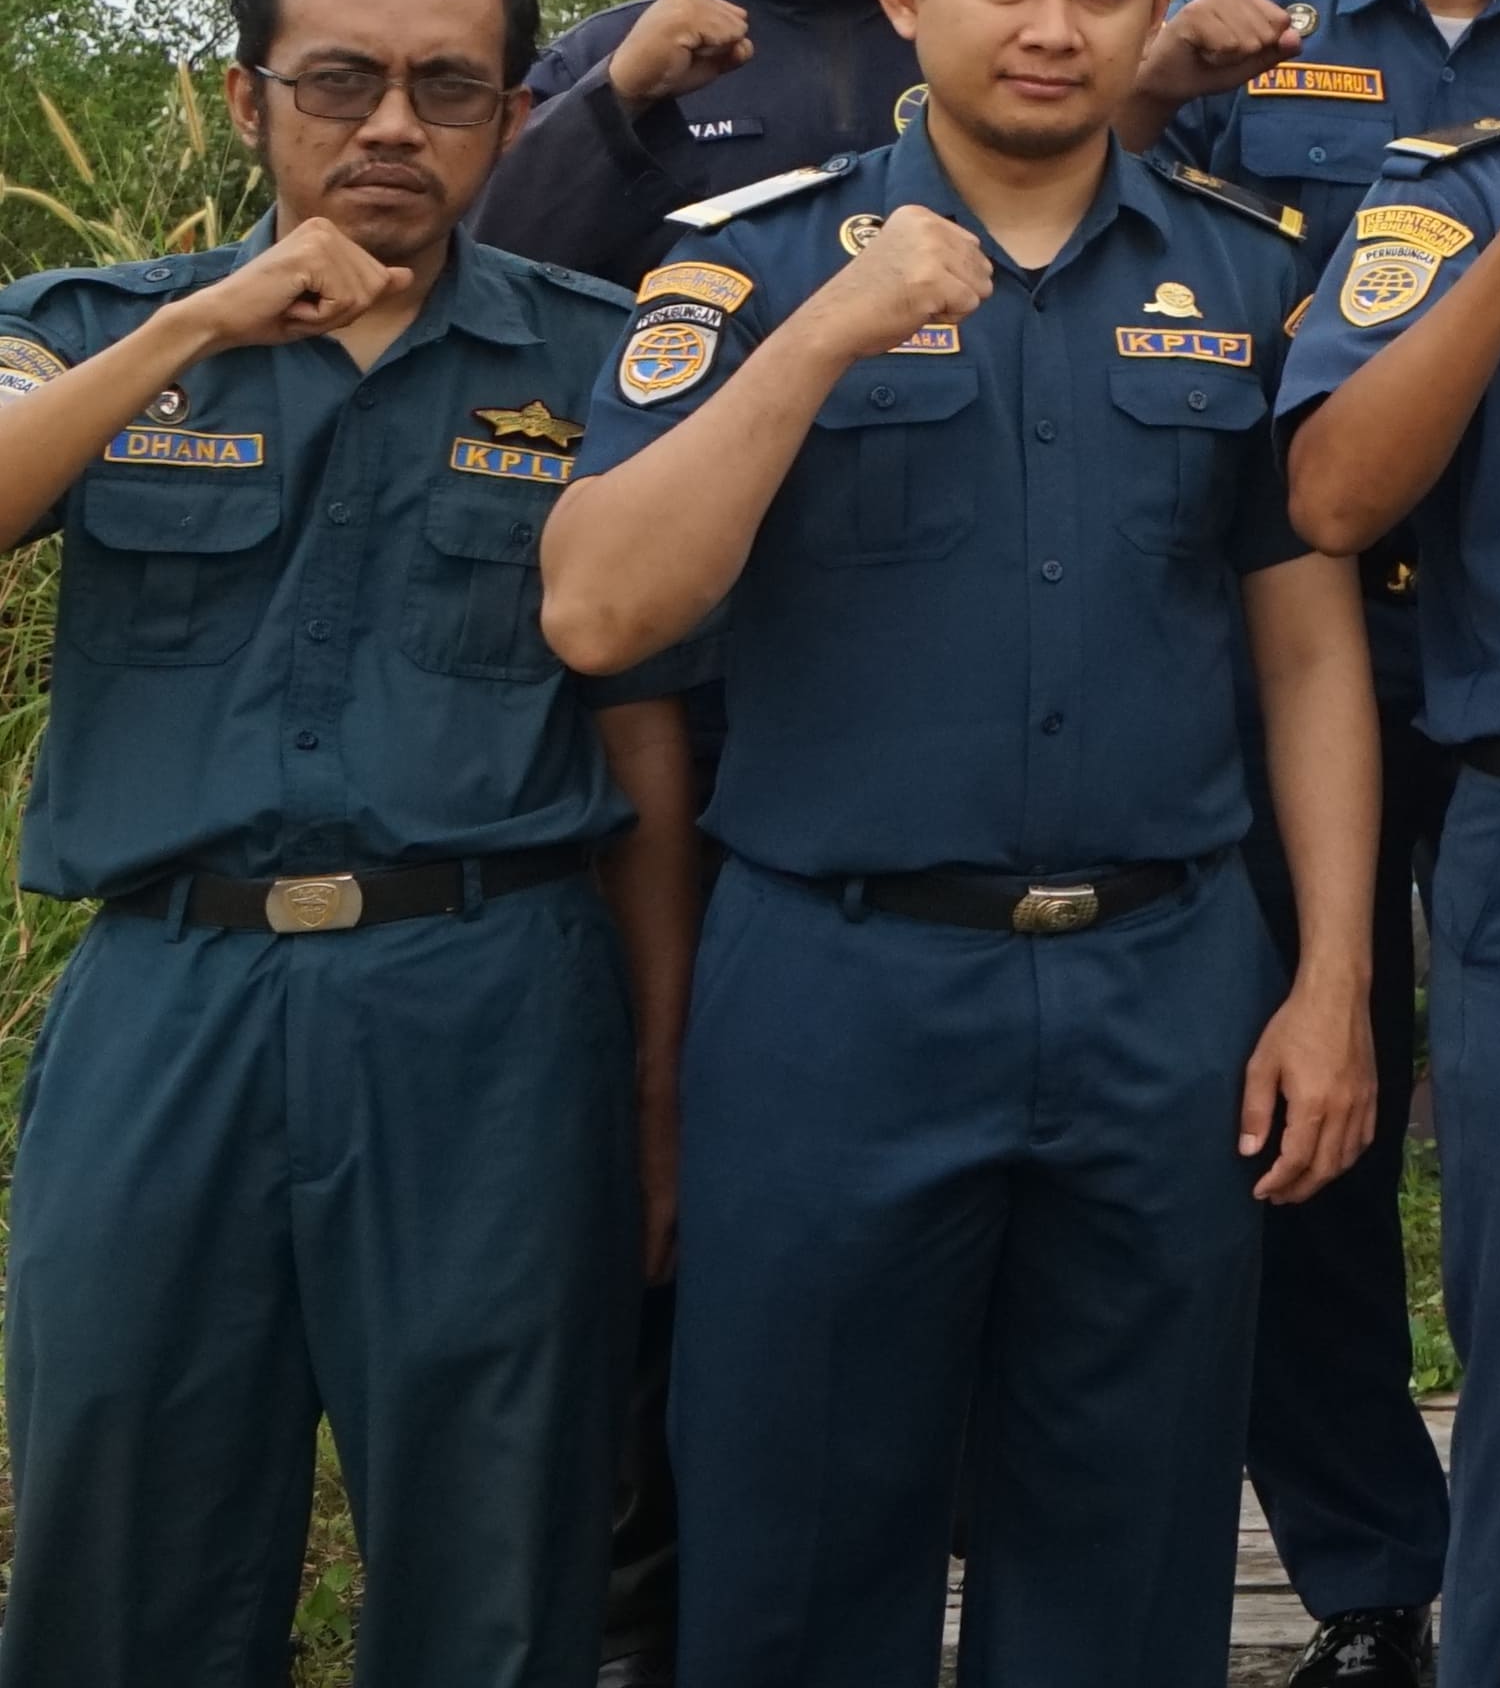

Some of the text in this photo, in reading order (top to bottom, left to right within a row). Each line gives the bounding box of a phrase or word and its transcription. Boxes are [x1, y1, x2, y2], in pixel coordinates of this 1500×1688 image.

[1305, 70, 1374, 93] SYAHRUL
[1365, 210, 1465, 245] KEMENTERIAN
[1129, 333, 1241, 358] KPLP
[127, 433, 241, 461] DHANA
